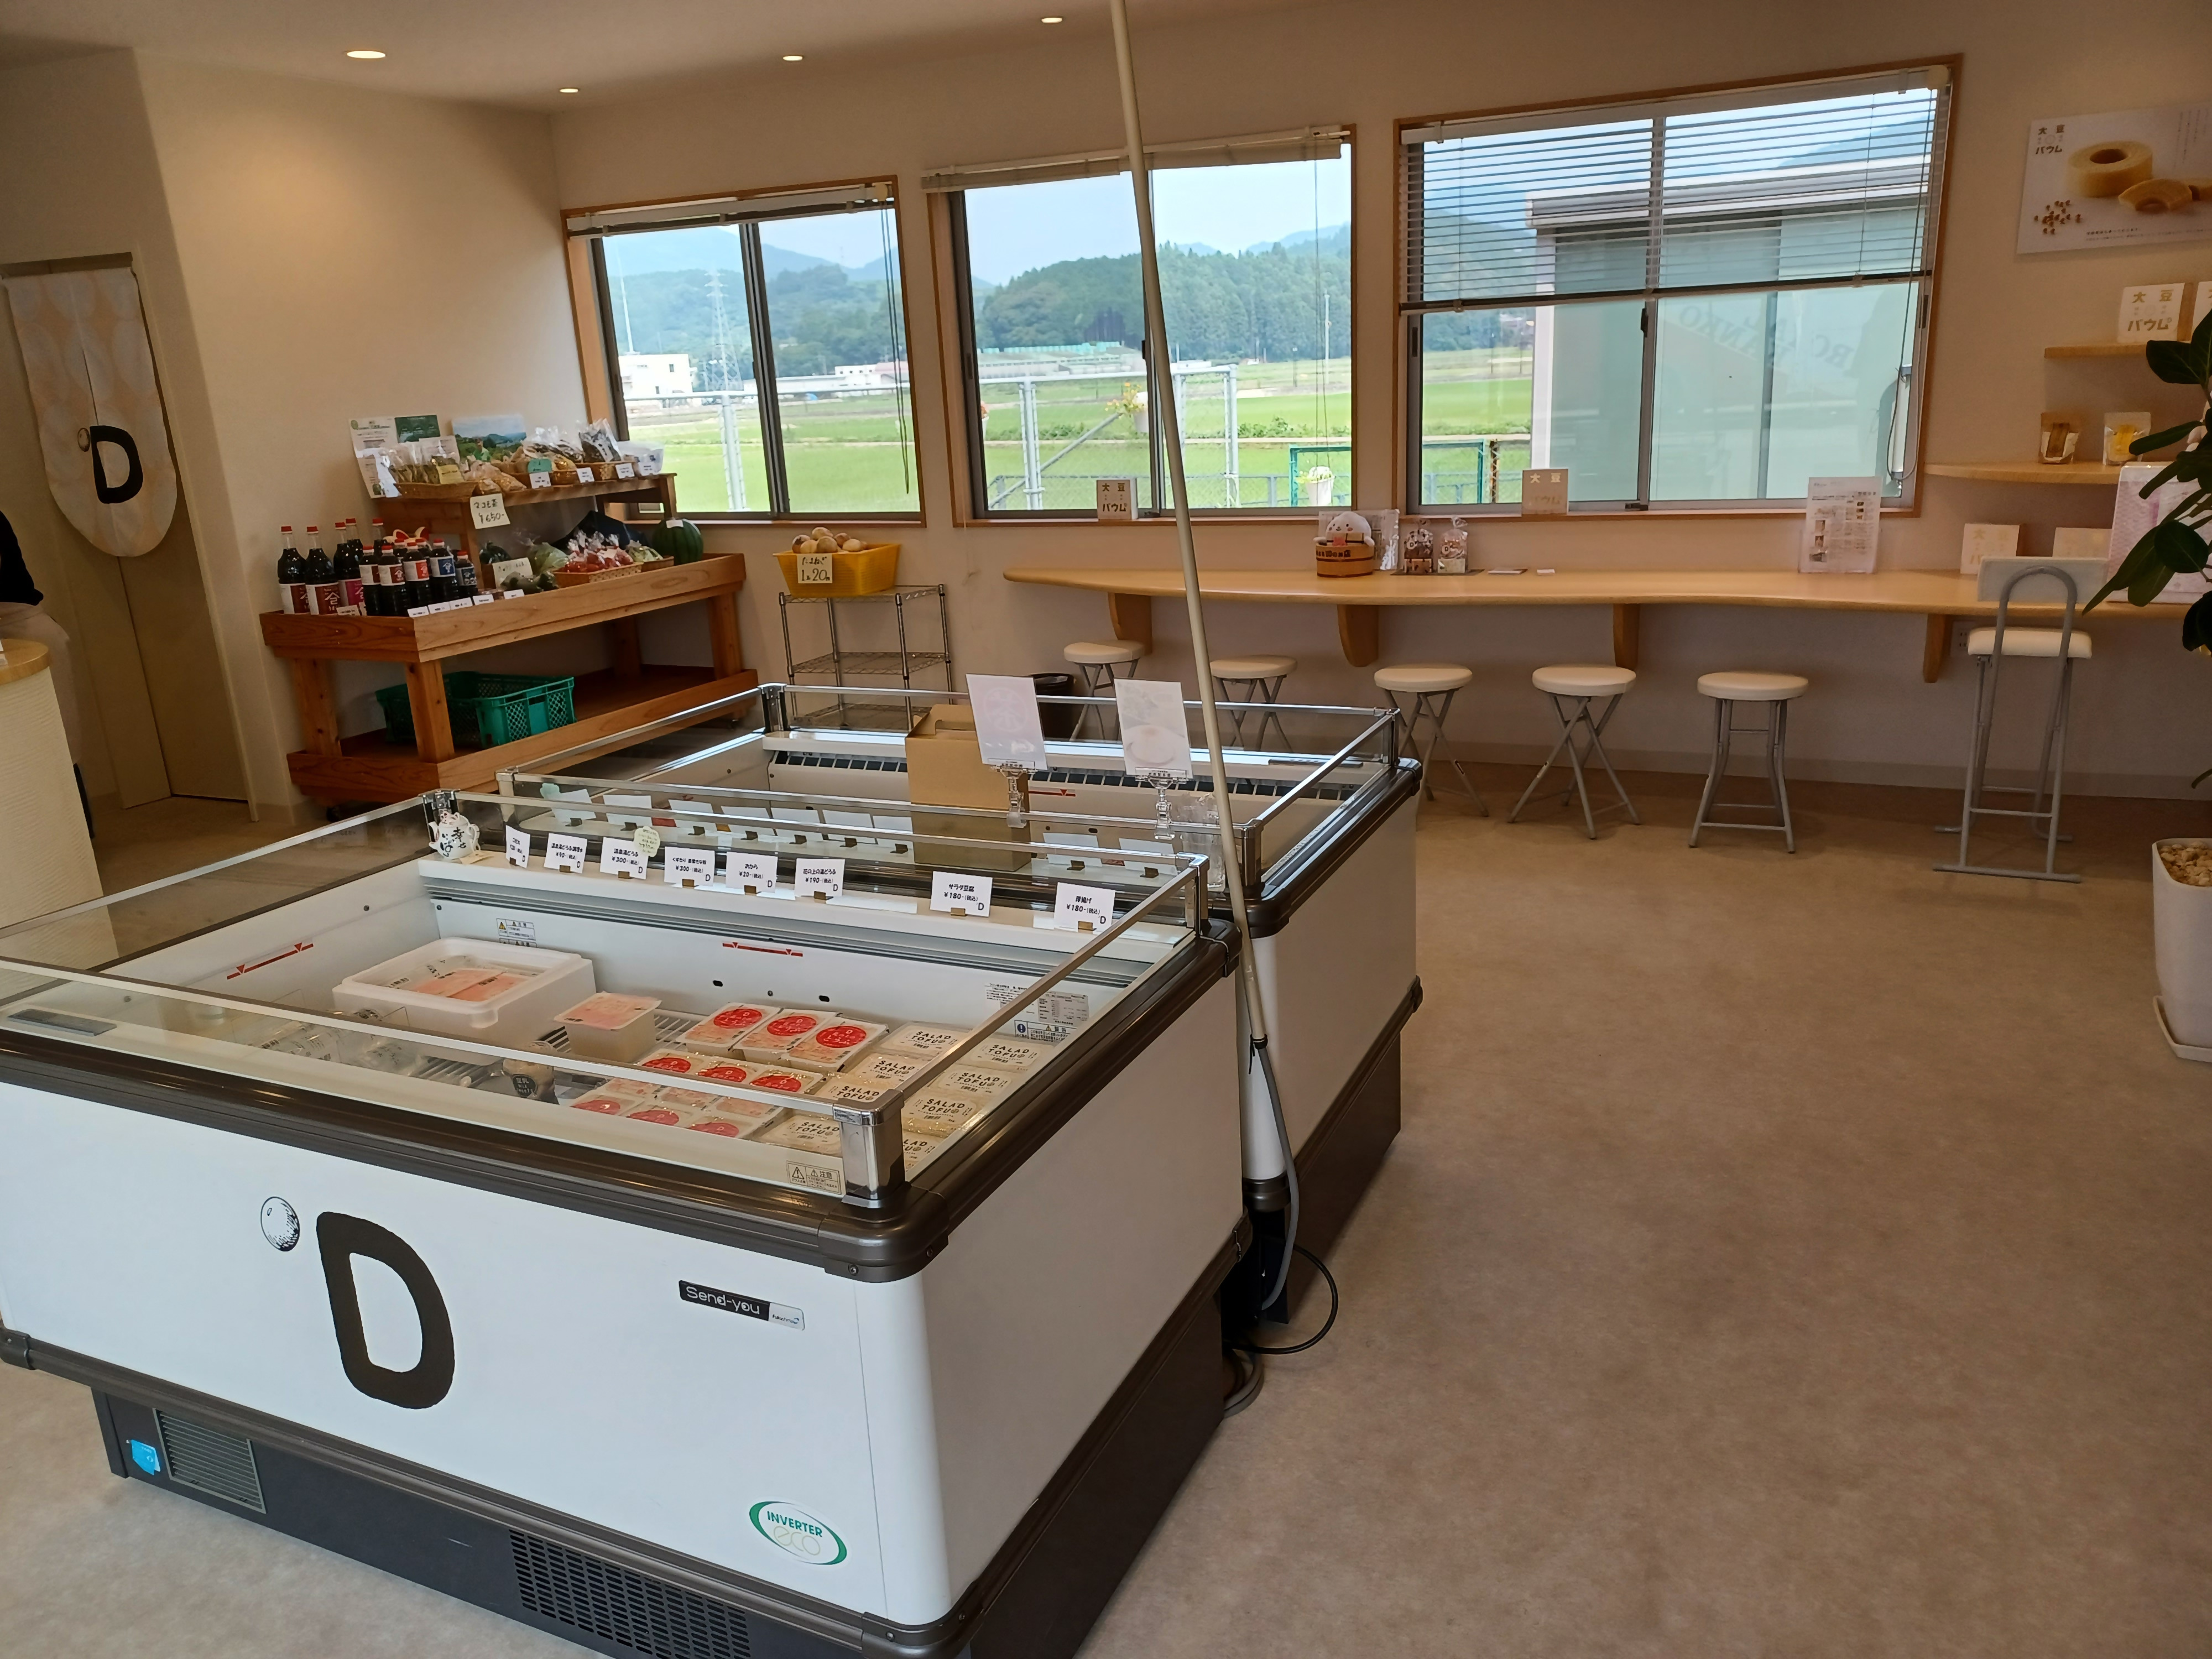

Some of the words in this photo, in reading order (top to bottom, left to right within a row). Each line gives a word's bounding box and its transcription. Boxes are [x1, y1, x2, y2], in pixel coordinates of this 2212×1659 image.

[2038, 124, 2065, 135] 大豆
[2036, 145, 2063, 155] バウム
[2132, 289, 2174, 304] 大豆
[2127, 319, 2169, 331] バウム
[90, 425, 144, 504] D
[1530, 472, 1561, 483] 大豆
[1102, 483, 1125, 492] 大豆
[1102, 503, 1126, 512] バウム
[451, 827, 467, 849] 幸せ
[948, 884, 974, 892] サラダ豆腐
[1075, 895, 1092, 904] 厚揚げ
[1099, 916, 1107, 924] D
[911, 1035, 938, 1044] TOFU
[916, 1031, 951, 1040] SALAD
[988, 1049, 1018, 1058] TOFU
[992, 1045, 1030, 1053] SALAD
[874, 1065, 901, 1074] TOFU
[879, 1060, 915, 1070] SALAD
[957, 1077, 988, 1087] TOFU
[961, 1072, 1000, 1082] SALAD
[837, 1091, 866, 1100] TOFU
[842, 1086, 880, 1096] SALAD
[926, 1098, 965, 1108] SALAD
[921, 1105, 951, 1113] TOFU
[801, 1122, 840, 1131] SALAD
[819, 1170, 833, 1180] 注意
[686, 1286, 760, 1314] Send-you
[316, 1211, 455, 1410] D
[767, 1510, 823, 1538] INVERTER
[773, 1525, 821, 1556] eco
